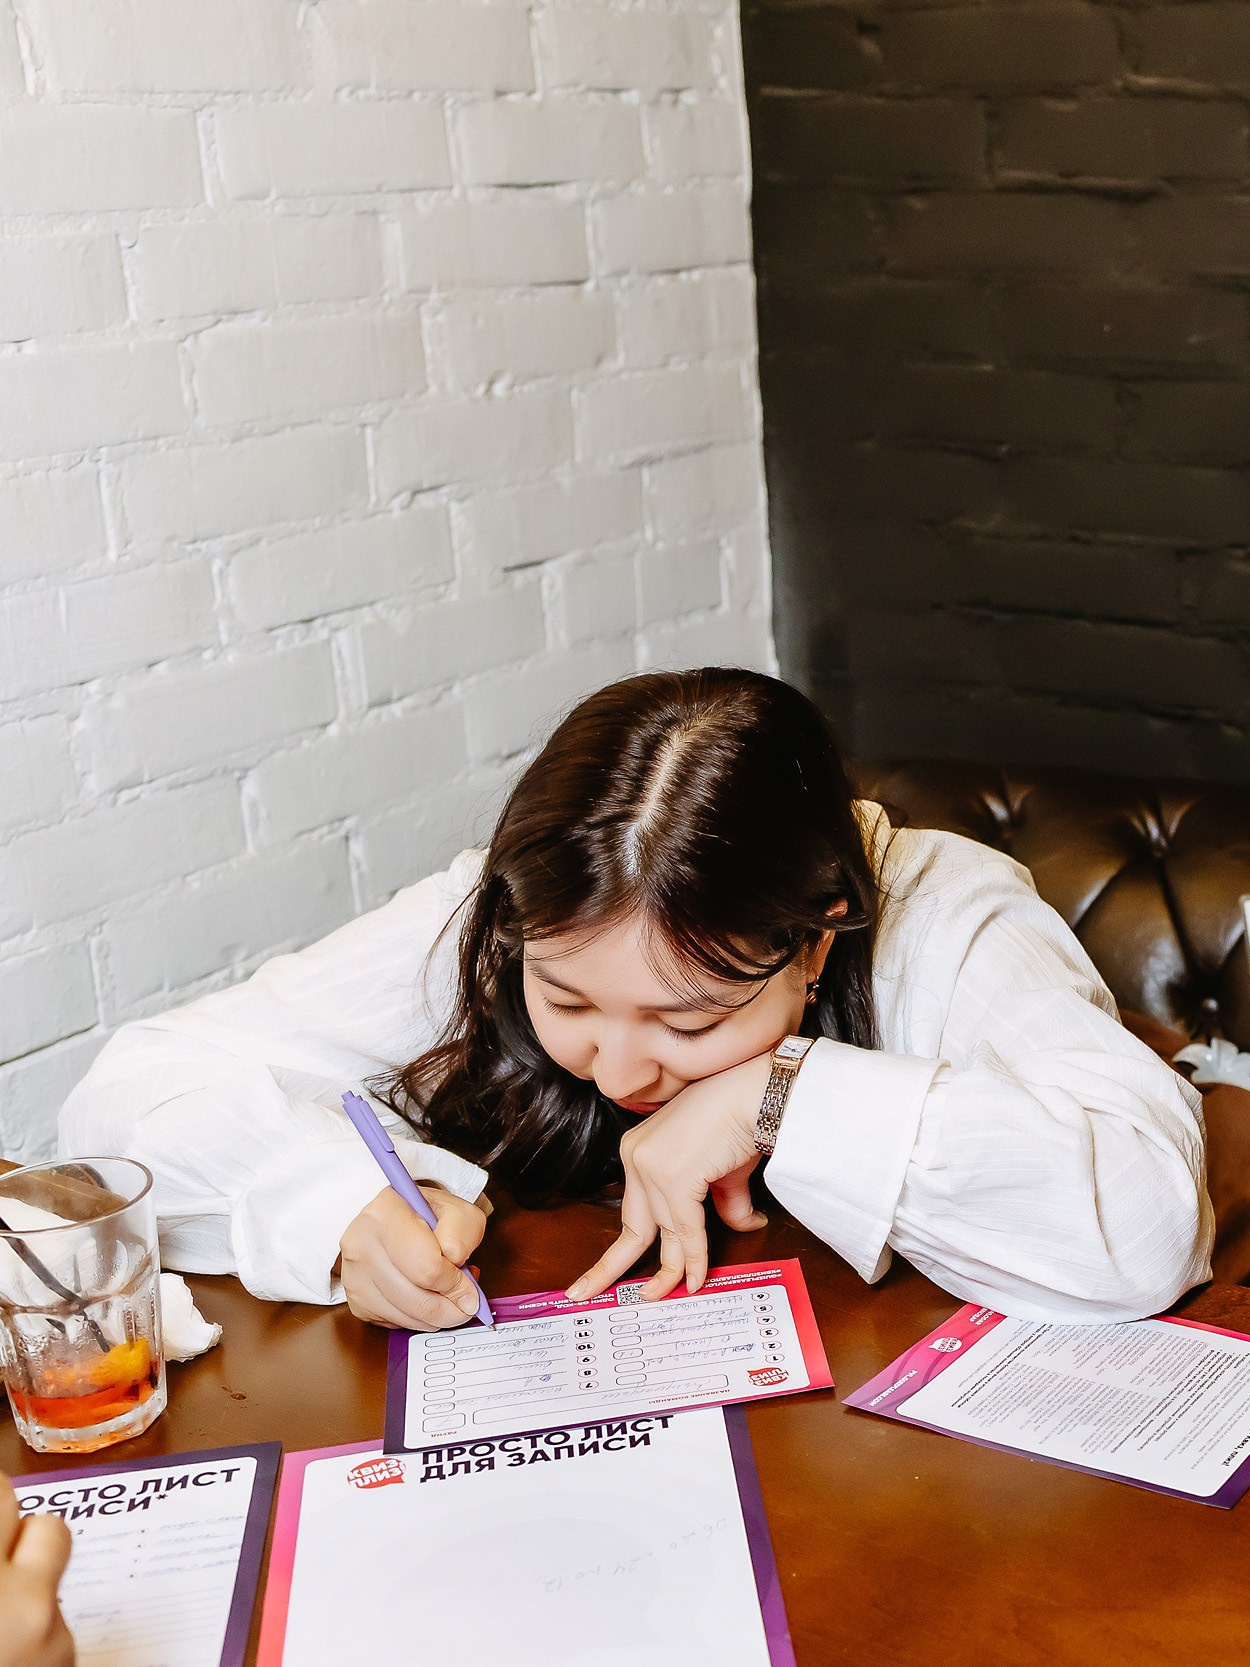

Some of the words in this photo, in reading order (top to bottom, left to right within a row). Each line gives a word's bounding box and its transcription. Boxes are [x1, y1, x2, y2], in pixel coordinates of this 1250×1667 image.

[754, 1370, 790, 1386] КВИЗ
[419, 1457, 496, 1484] ДЛЯ
[506, 1433, 652, 1468] ЗАПИСИ
[422, 1430, 570, 1466] ПРОСТО
[580, 1414, 675, 1441] ЛИСТ
[19, 1483, 127, 1511] ОСТО
[136, 1467, 241, 1496] ЛИСТ
[348, 1460, 401, 1480] КВИЗ
